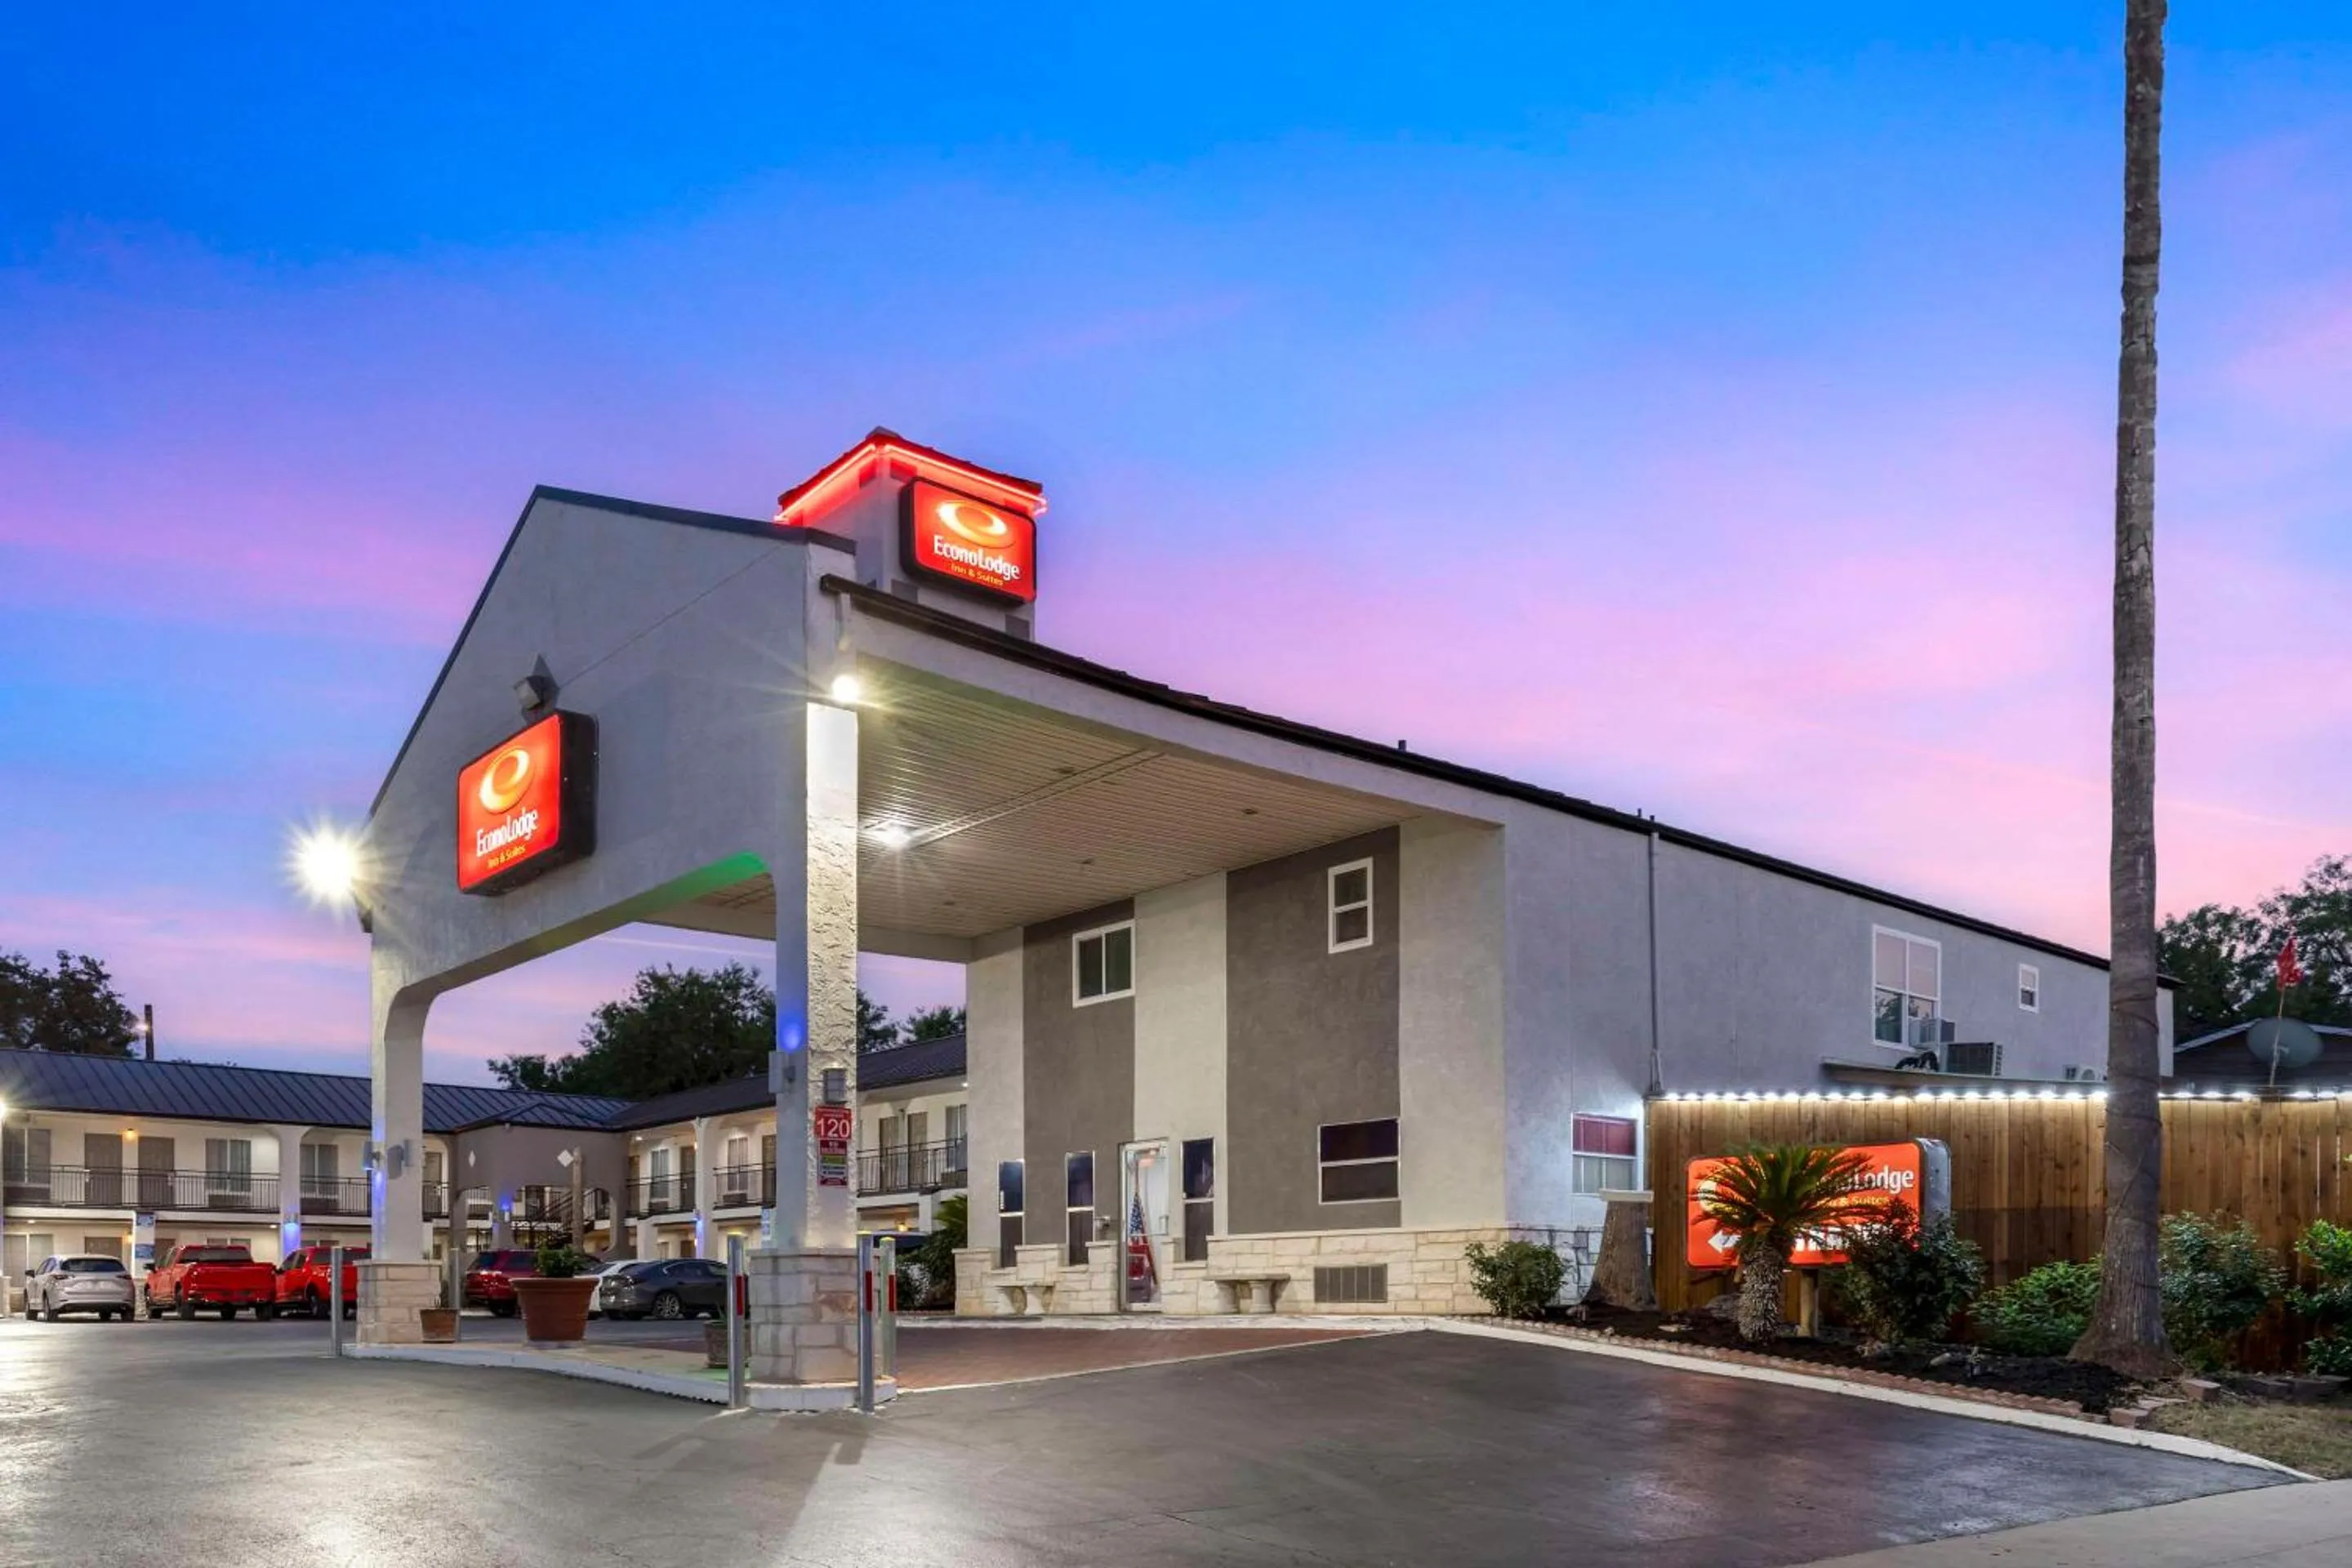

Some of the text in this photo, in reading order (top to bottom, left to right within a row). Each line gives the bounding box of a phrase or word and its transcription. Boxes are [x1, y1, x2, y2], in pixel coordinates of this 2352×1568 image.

[933, 535, 1020, 581] EconoLodge
[951, 561, 1004, 586] Inn & Suites
[476, 808, 538, 858] EconoLodge
[817, 1118, 850, 1138] 120
[1851, 1196, 1889, 1205] Suites
